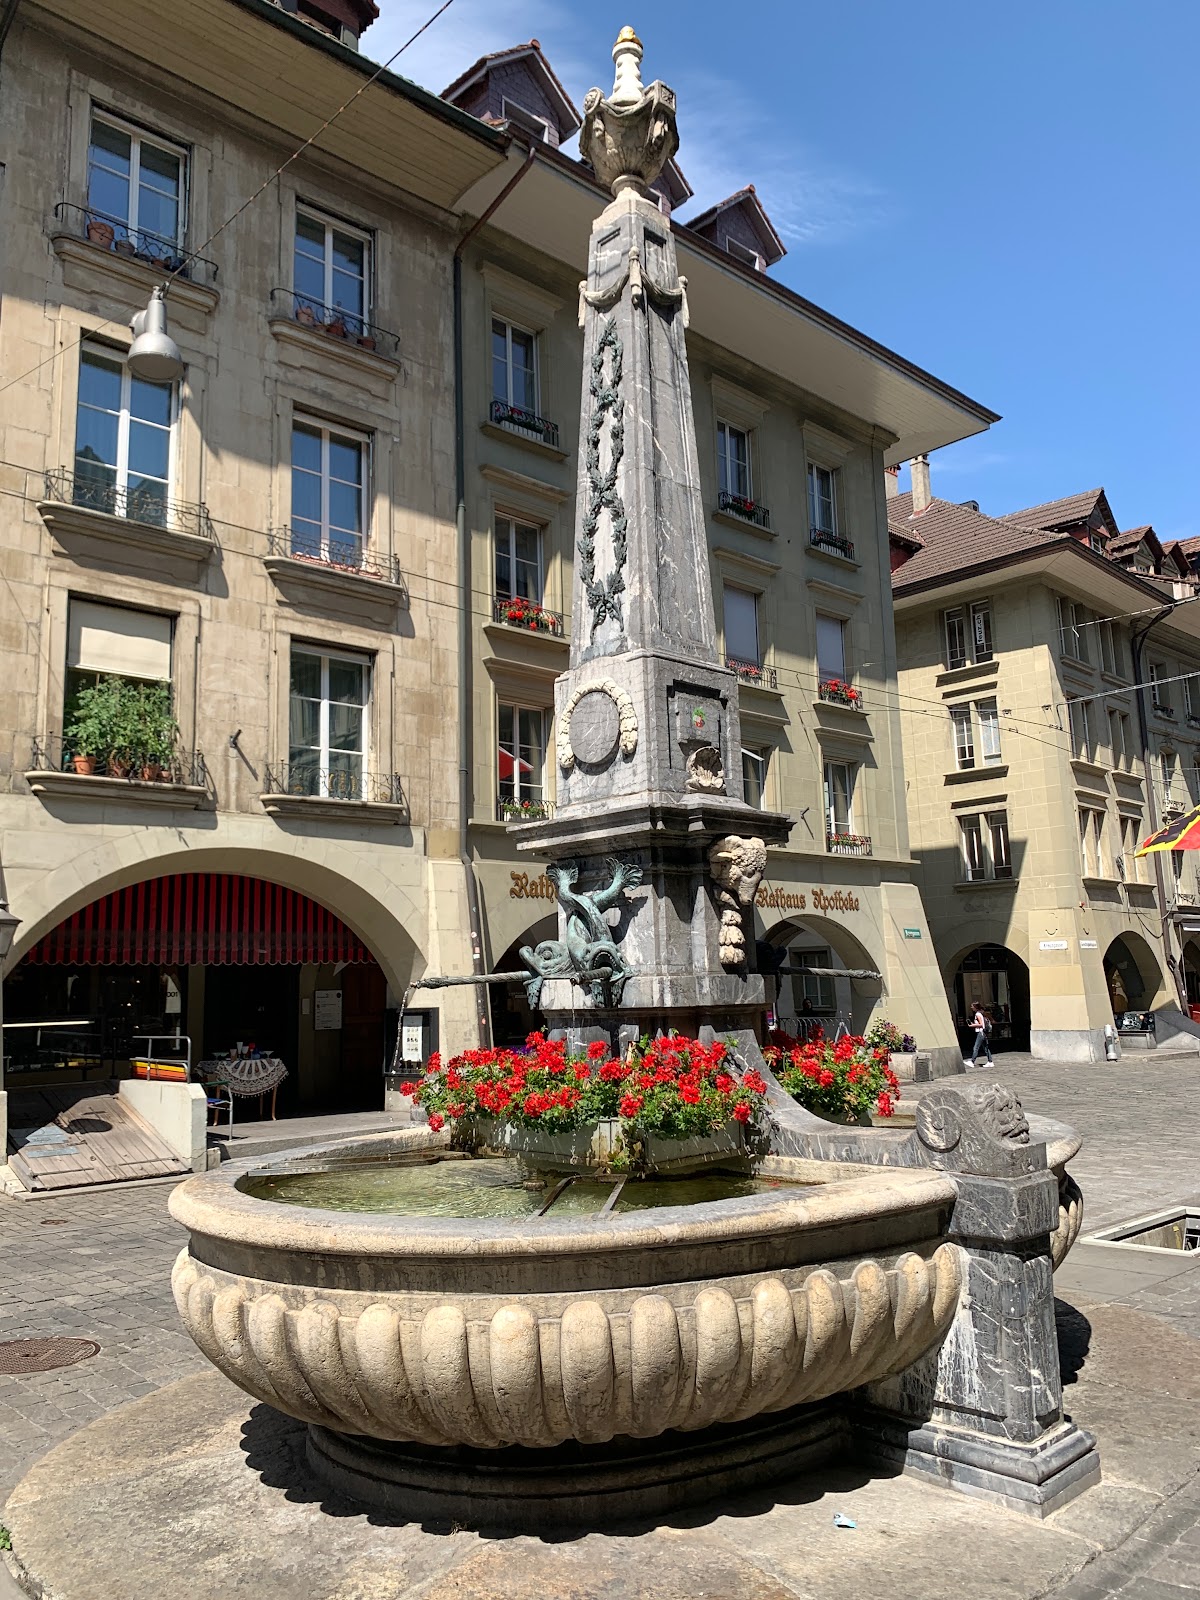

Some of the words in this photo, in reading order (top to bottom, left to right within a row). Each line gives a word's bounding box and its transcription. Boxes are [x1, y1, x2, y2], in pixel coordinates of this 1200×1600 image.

[509, 870, 558, 903] Rath
[755, 886, 807, 912] Rathaus
[811, 887, 860, 916] Apotheke
